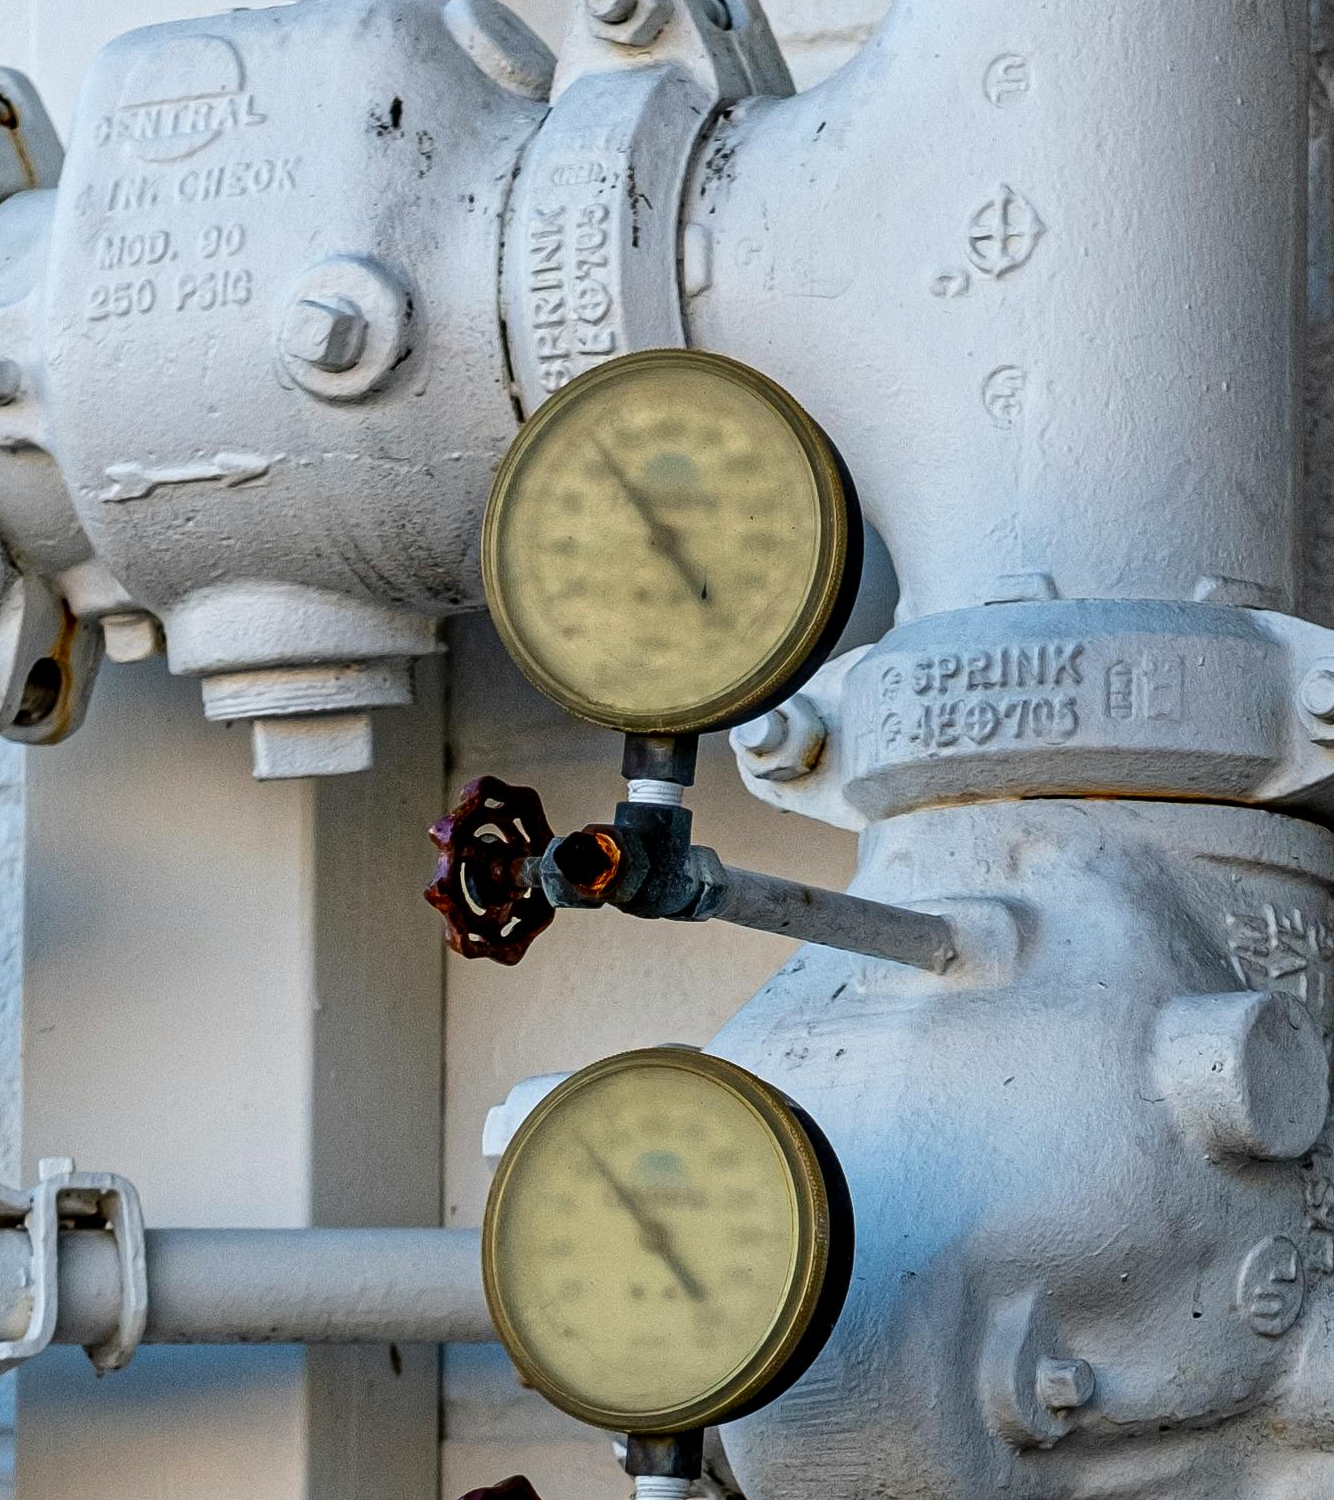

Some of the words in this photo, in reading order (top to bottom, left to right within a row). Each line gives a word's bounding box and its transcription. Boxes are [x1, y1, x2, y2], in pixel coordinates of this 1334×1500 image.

[86, 277, 159, 323] 250
[530, 202, 573, 395] SPRINK
[912, 642, 1087, 696] SPRINK
